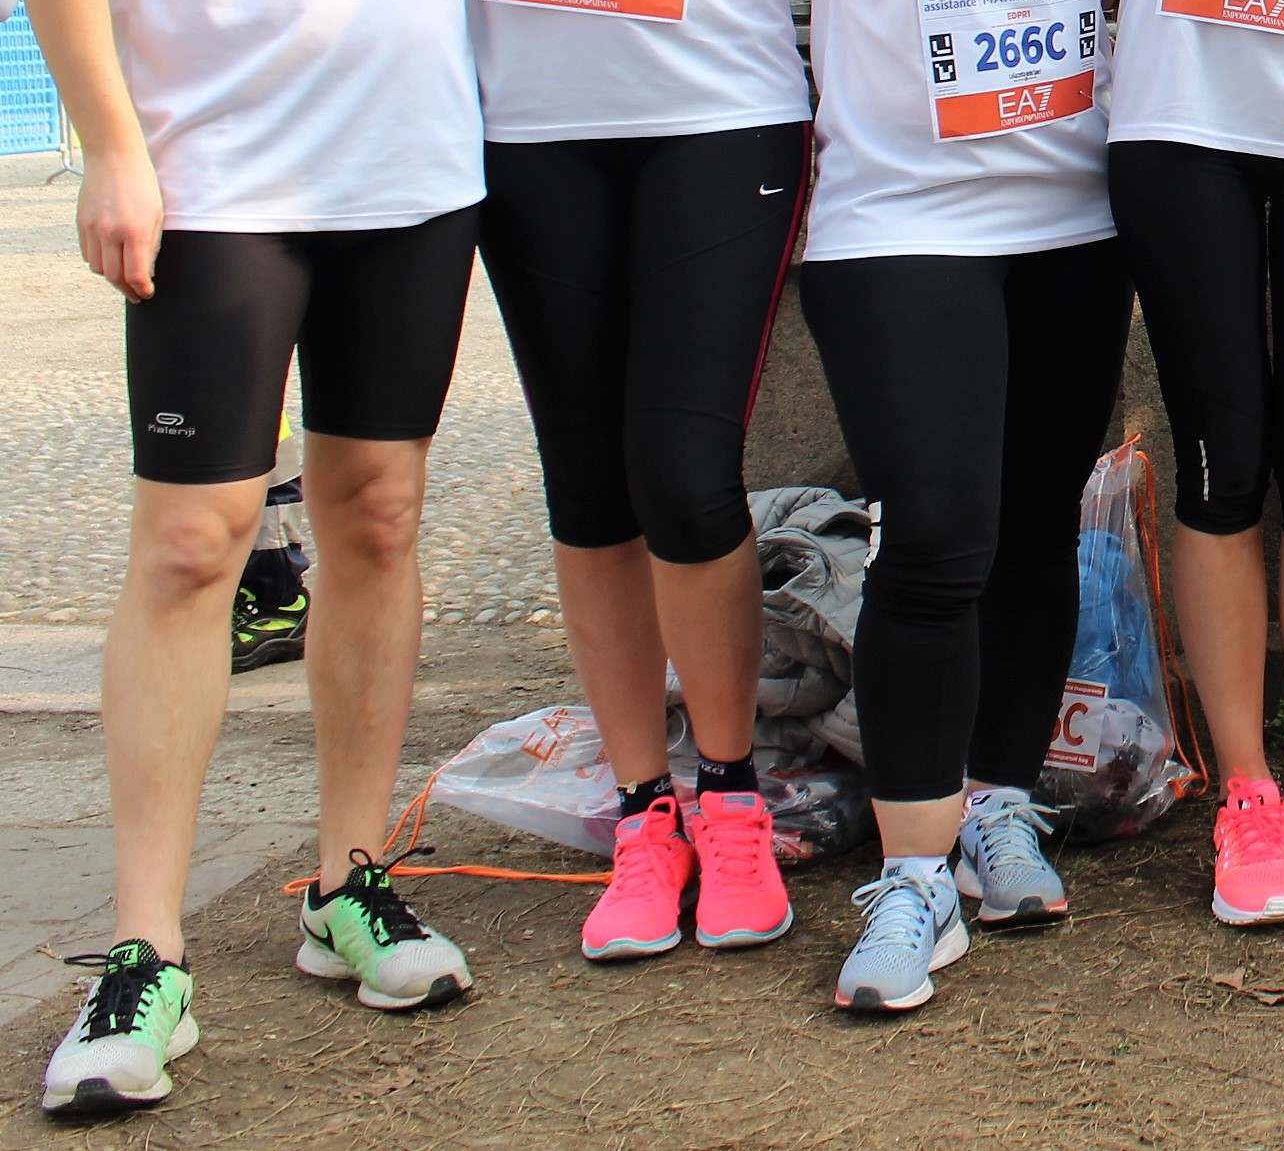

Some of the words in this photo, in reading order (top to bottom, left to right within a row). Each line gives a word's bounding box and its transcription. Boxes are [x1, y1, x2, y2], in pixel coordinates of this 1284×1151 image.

[924, 0, 977, 12] assistance
[1007, 10, 1030, 20] EDPR1
[1222, 10, 1252, 22] EMPORIO
[973, 22, 1067, 72] 266C
[998, 84, 1054, 118] EA7
[148, 424, 195, 437] Kalenji
